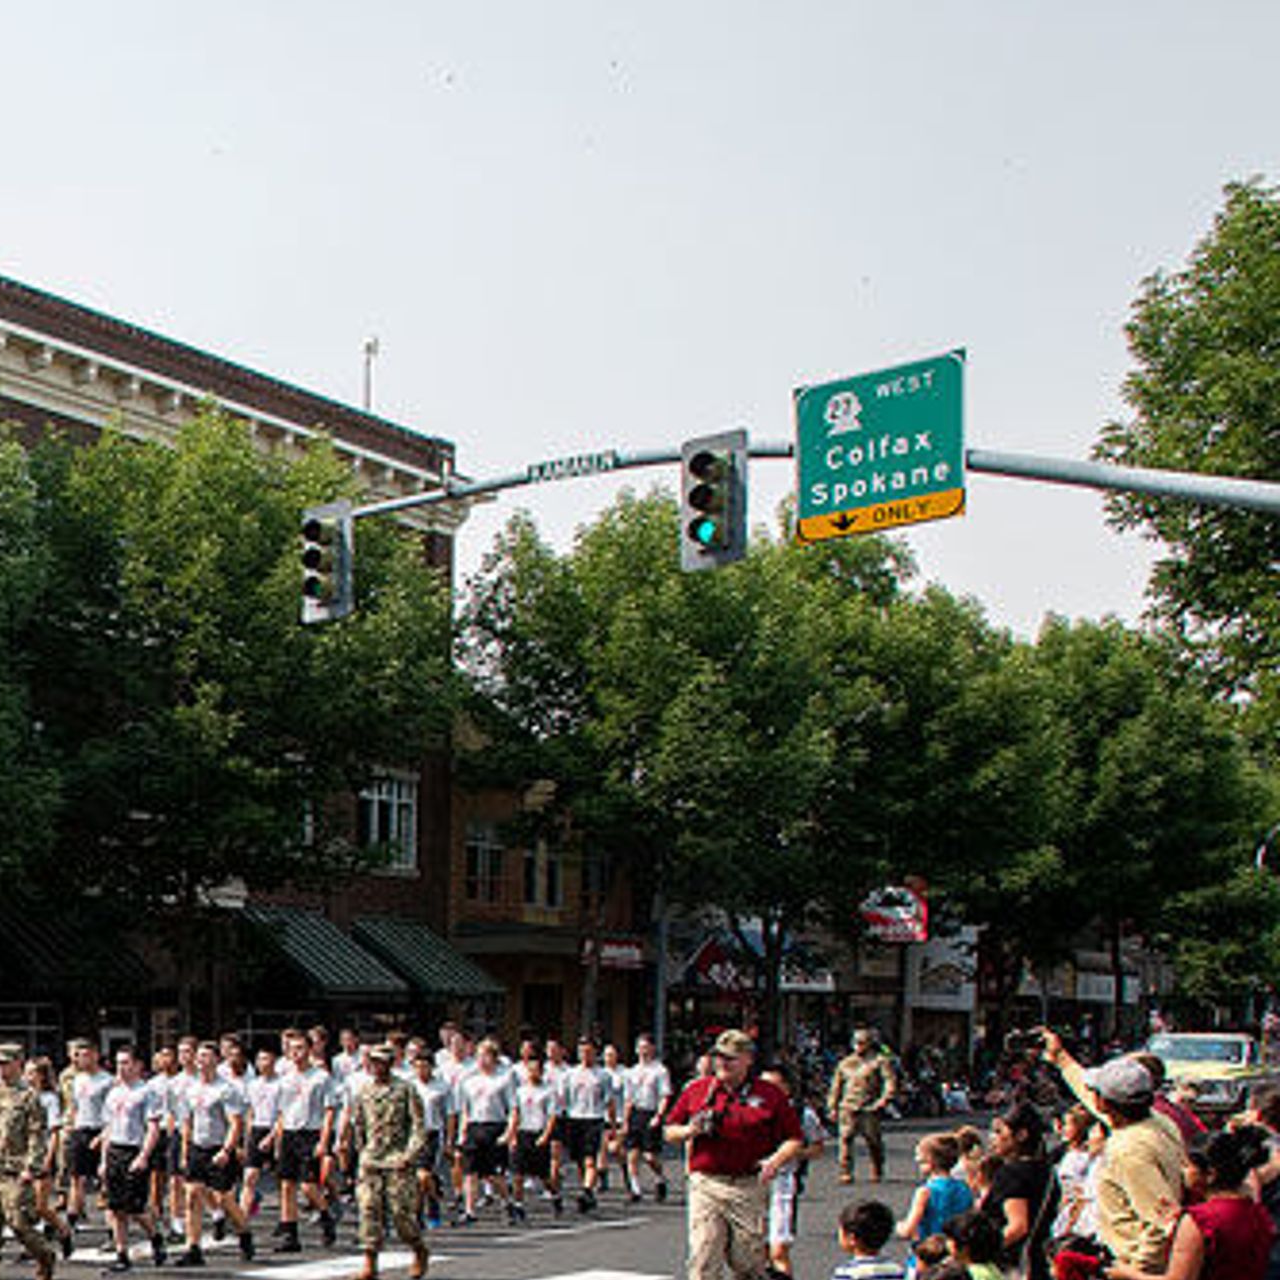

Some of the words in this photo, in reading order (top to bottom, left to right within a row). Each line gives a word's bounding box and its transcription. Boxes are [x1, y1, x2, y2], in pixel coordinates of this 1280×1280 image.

[876, 369, 935, 398] WEST
[826, 432, 932, 470] Colfax
[810, 462, 951, 505] Spokane
[872, 503, 930, 523] ONLY
